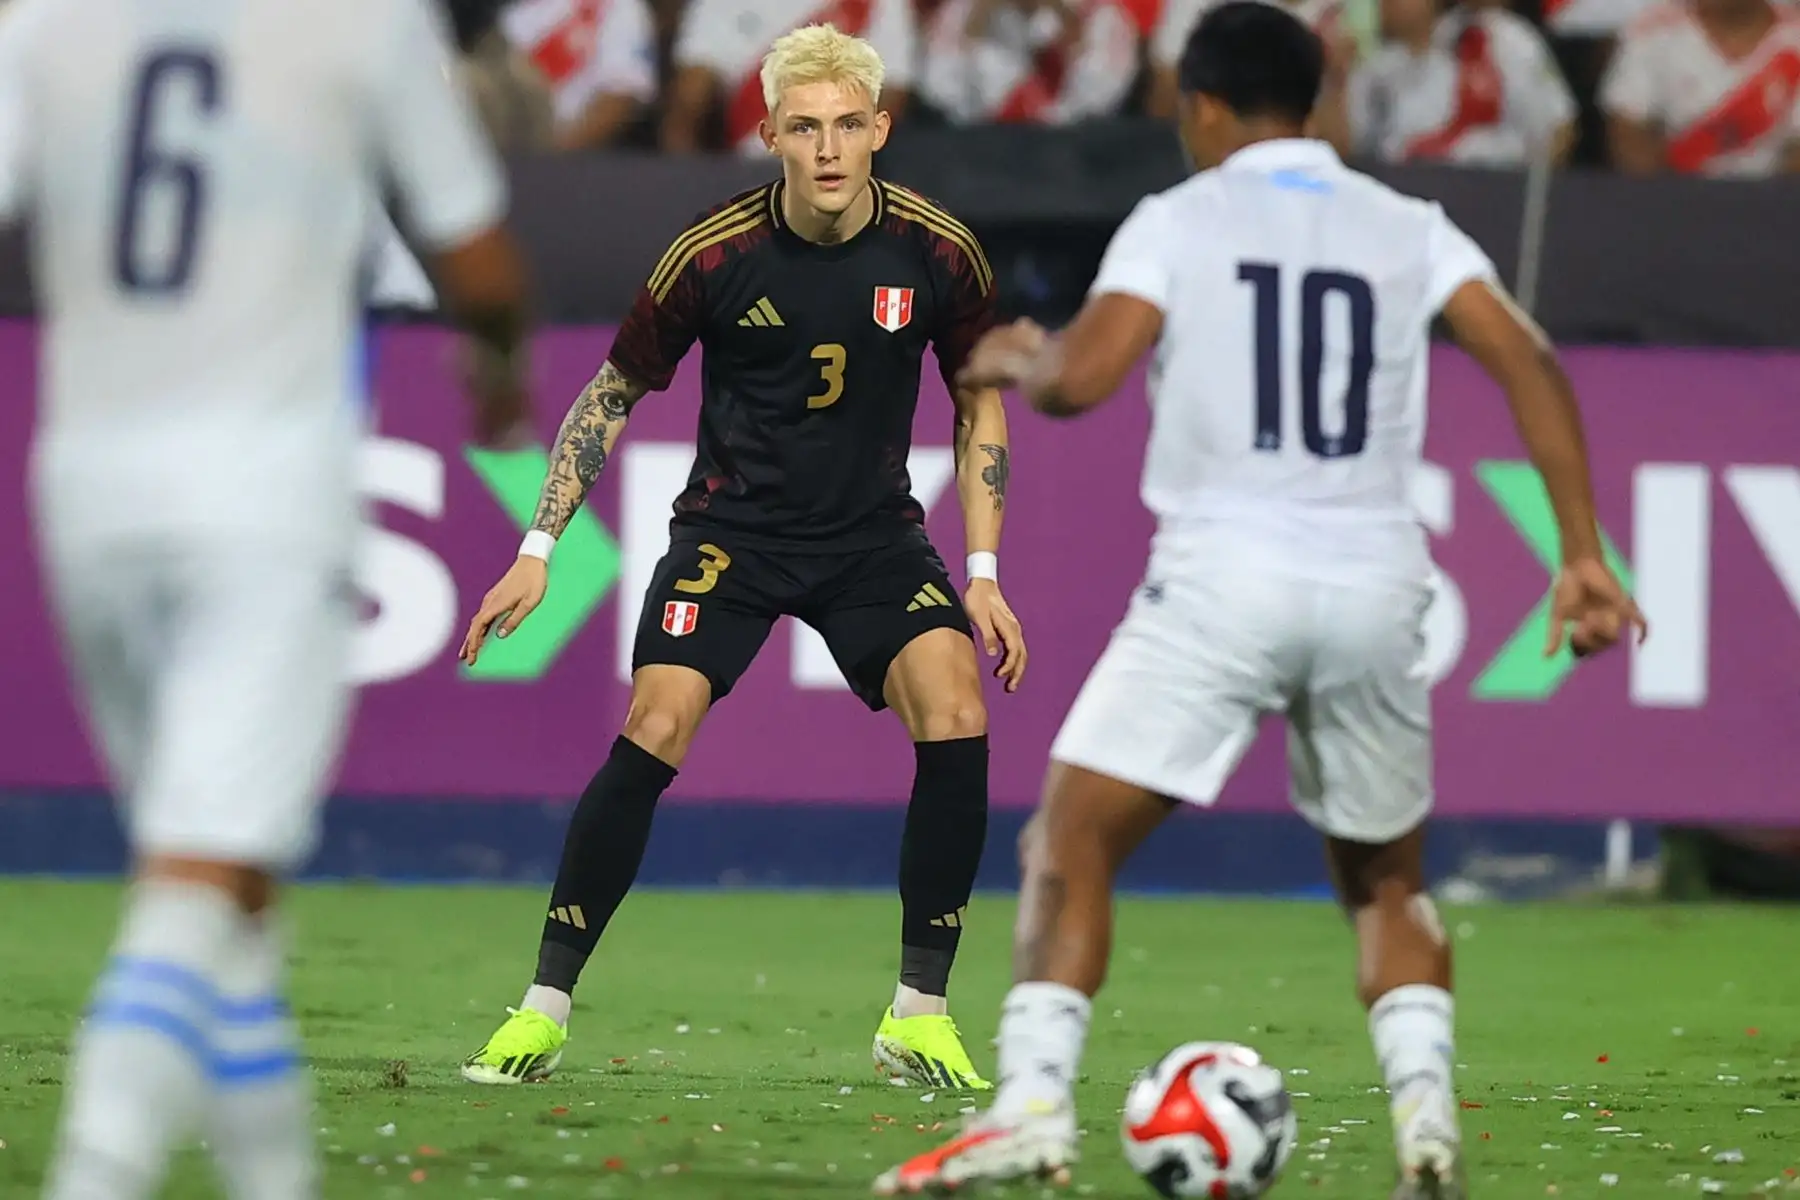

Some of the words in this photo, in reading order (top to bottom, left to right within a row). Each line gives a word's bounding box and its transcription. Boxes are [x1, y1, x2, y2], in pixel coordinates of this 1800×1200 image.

[118, 50, 216, 292] 6
[879, 300, 908, 312] FPF
[807, 344, 846, 408] 3
[1237, 264, 1373, 457] 10
[673, 543, 731, 593] 3
